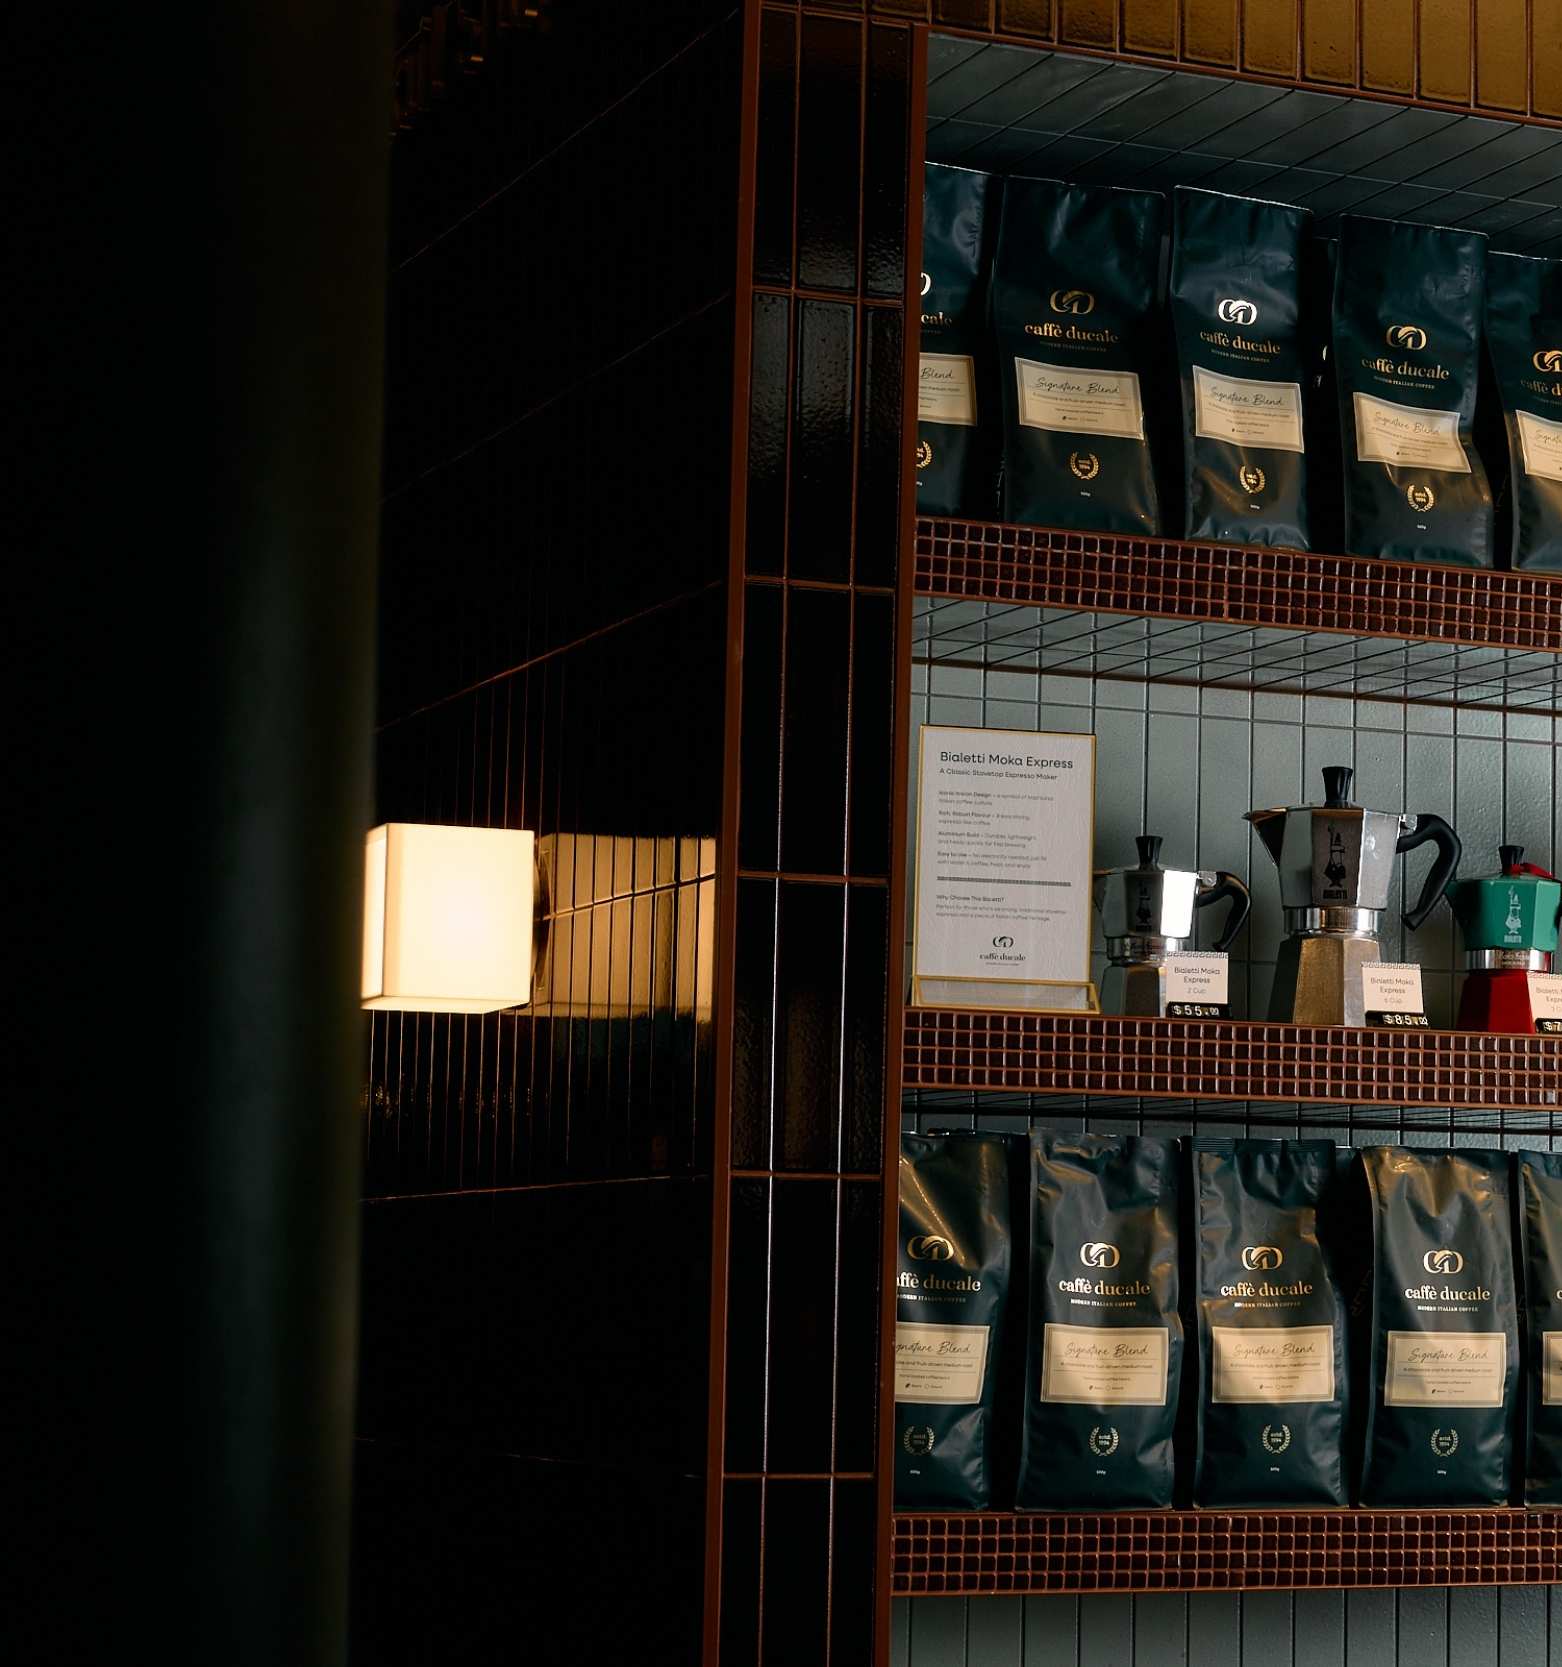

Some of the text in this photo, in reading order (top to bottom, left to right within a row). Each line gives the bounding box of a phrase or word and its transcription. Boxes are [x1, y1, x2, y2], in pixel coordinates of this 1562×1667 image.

[921, 311, 952, 326] cale
[1024, 322, 1120, 344] caffè ducale
[1199, 329, 1281, 355] caffè ducale
[1361, 356, 1450, 381] caffè ducale
[1034, 377, 1120, 395] Signature Blend
[940, 751, 1074, 769] Bialetti Moka Express
[945, 768, 970, 776] Classic
[972, 769, 1004, 778] Stovetop
[1004, 771, 1035, 780] Espresso
[1174, 966, 1221, 975] Bialetti Moka
[1183, 976, 1211, 985] Express
[897, 1271, 981, 1291] ffè ducale
[1059, 1278, 1151, 1295] caffè ducale
[1220, 1281, 1313, 1297] caffè ducale
[1404, 1285, 1491, 1302] caffè ducale
[1111, 1343, 1149, 1358] Blend
[1279, 1342, 1316, 1357] Blend
[1407, 1347, 1489, 1363] Signature Blend
